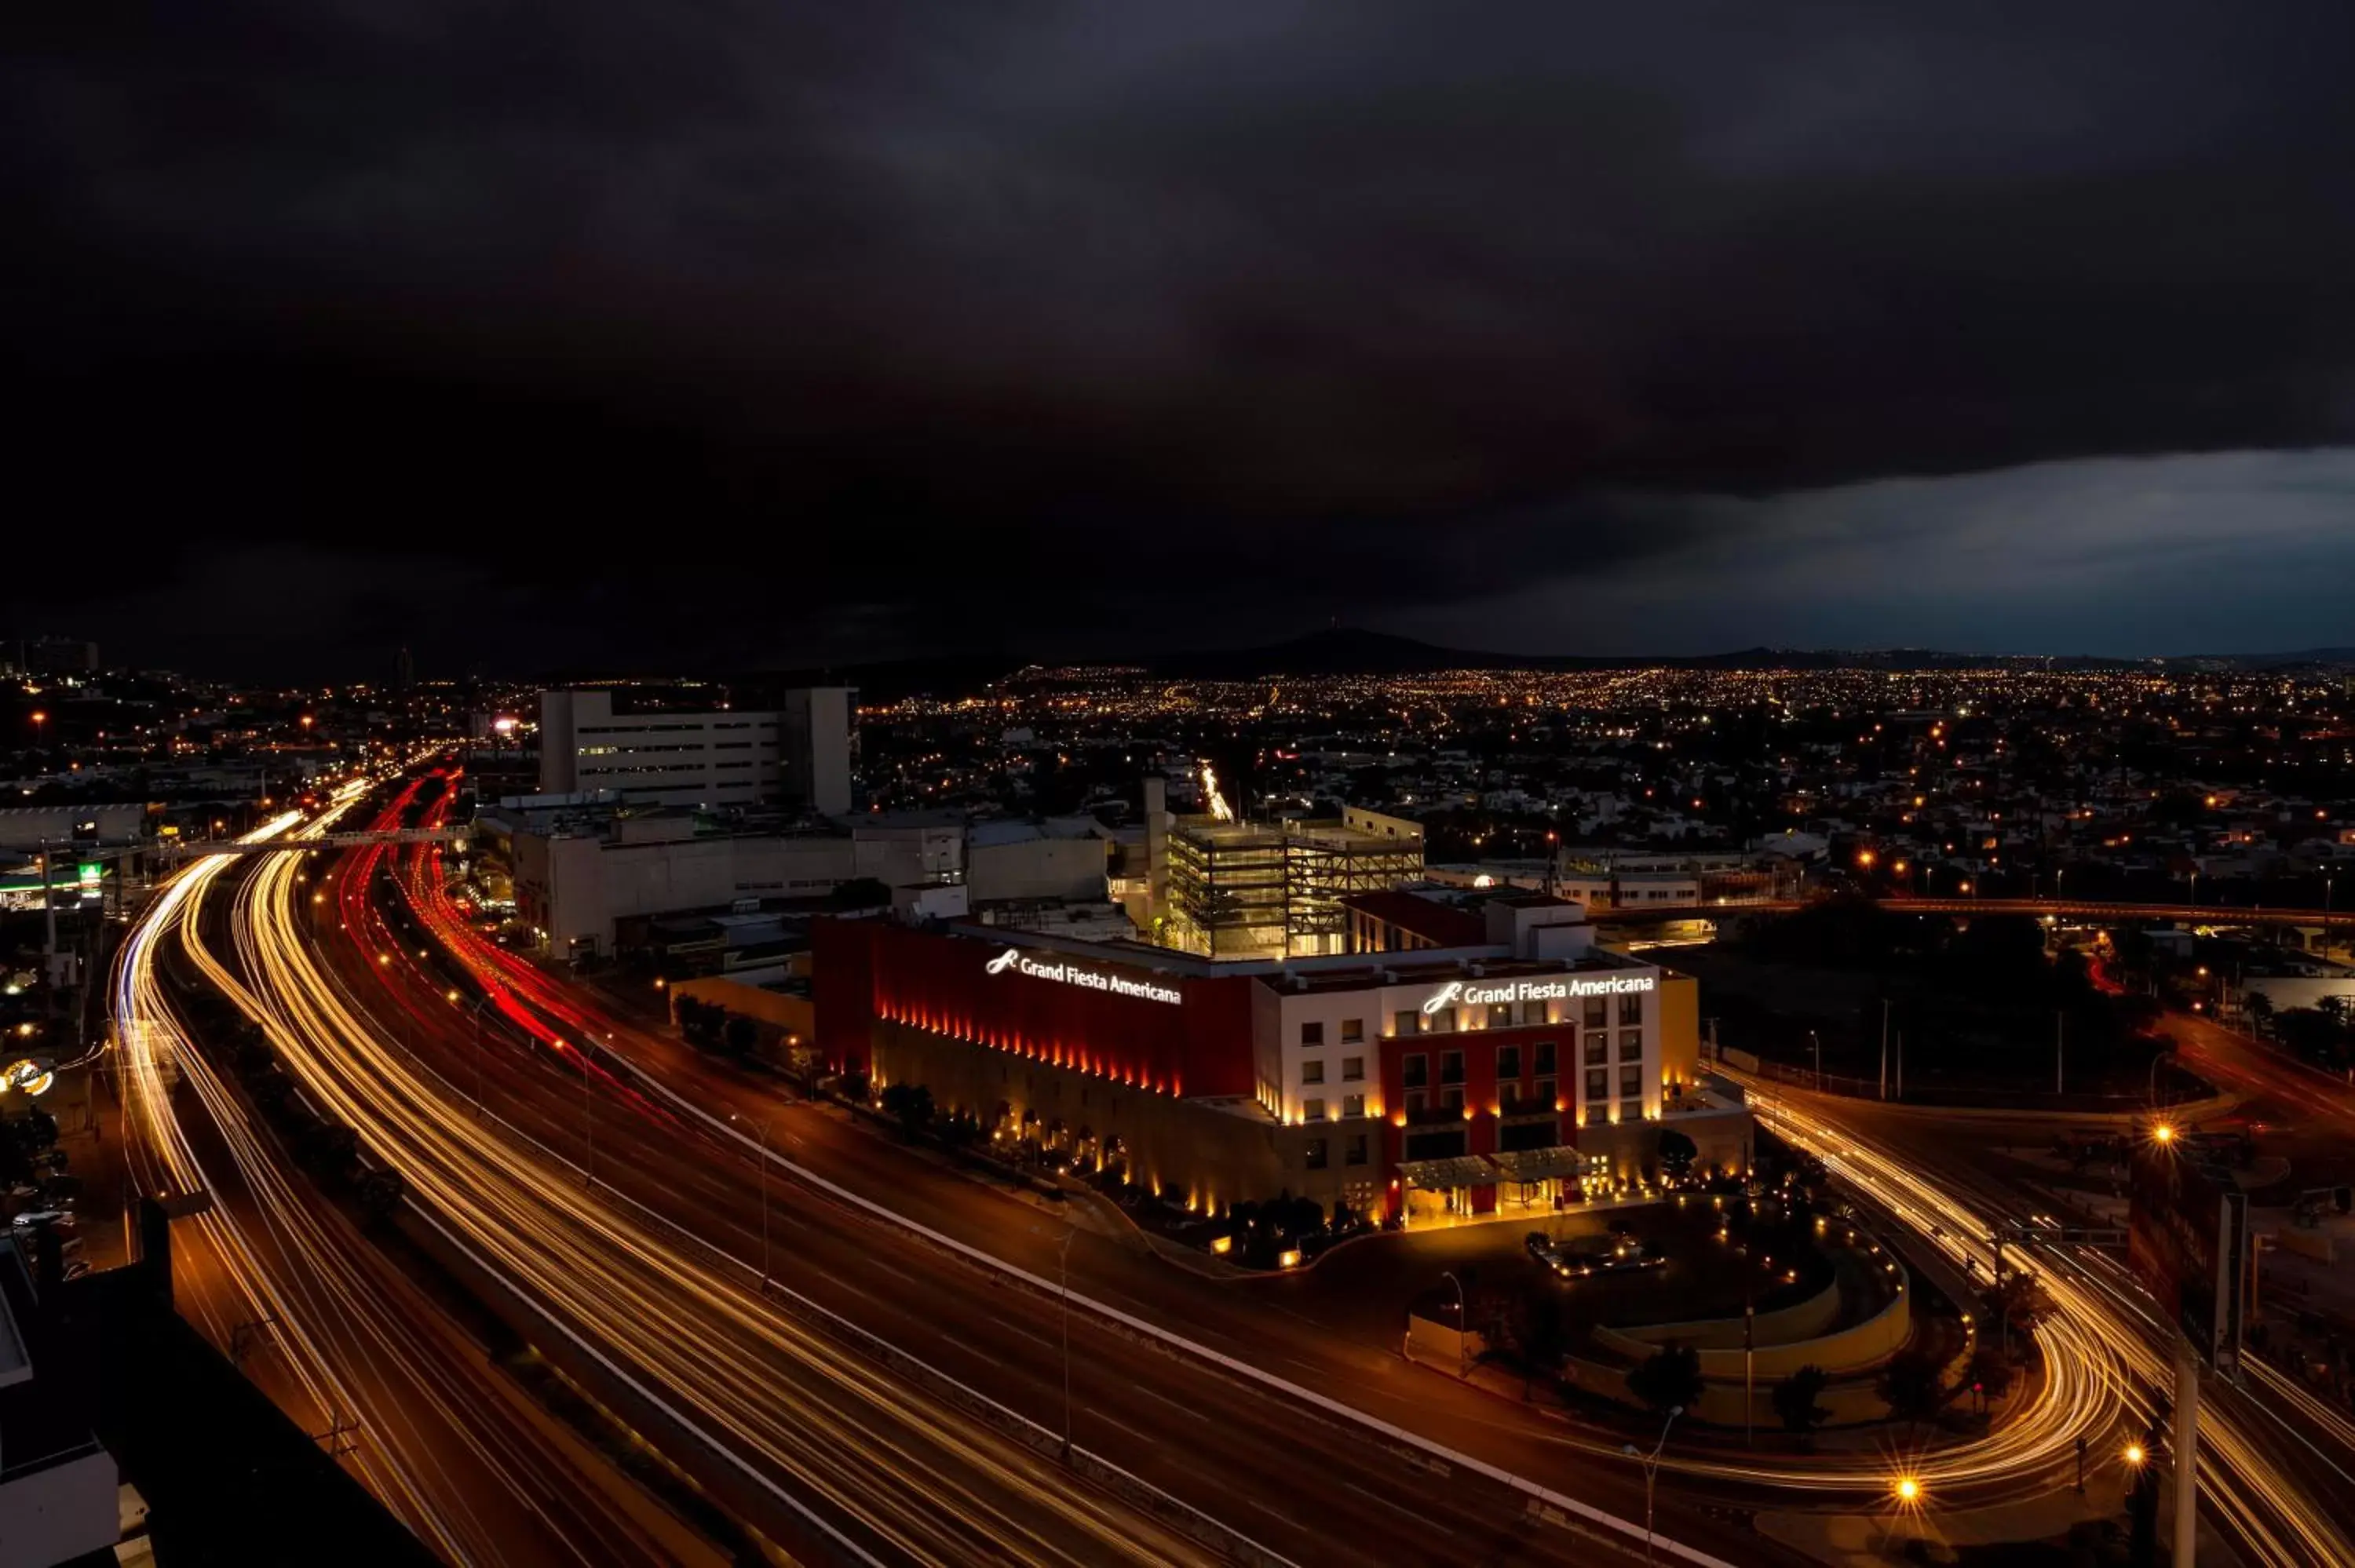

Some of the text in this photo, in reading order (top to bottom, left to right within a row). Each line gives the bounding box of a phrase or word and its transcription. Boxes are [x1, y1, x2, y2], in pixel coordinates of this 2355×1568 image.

[1020, 957, 1182, 1005] Grand Fiesta Americana
[1464, 975, 1654, 1004] Grand Fiesta Americana
